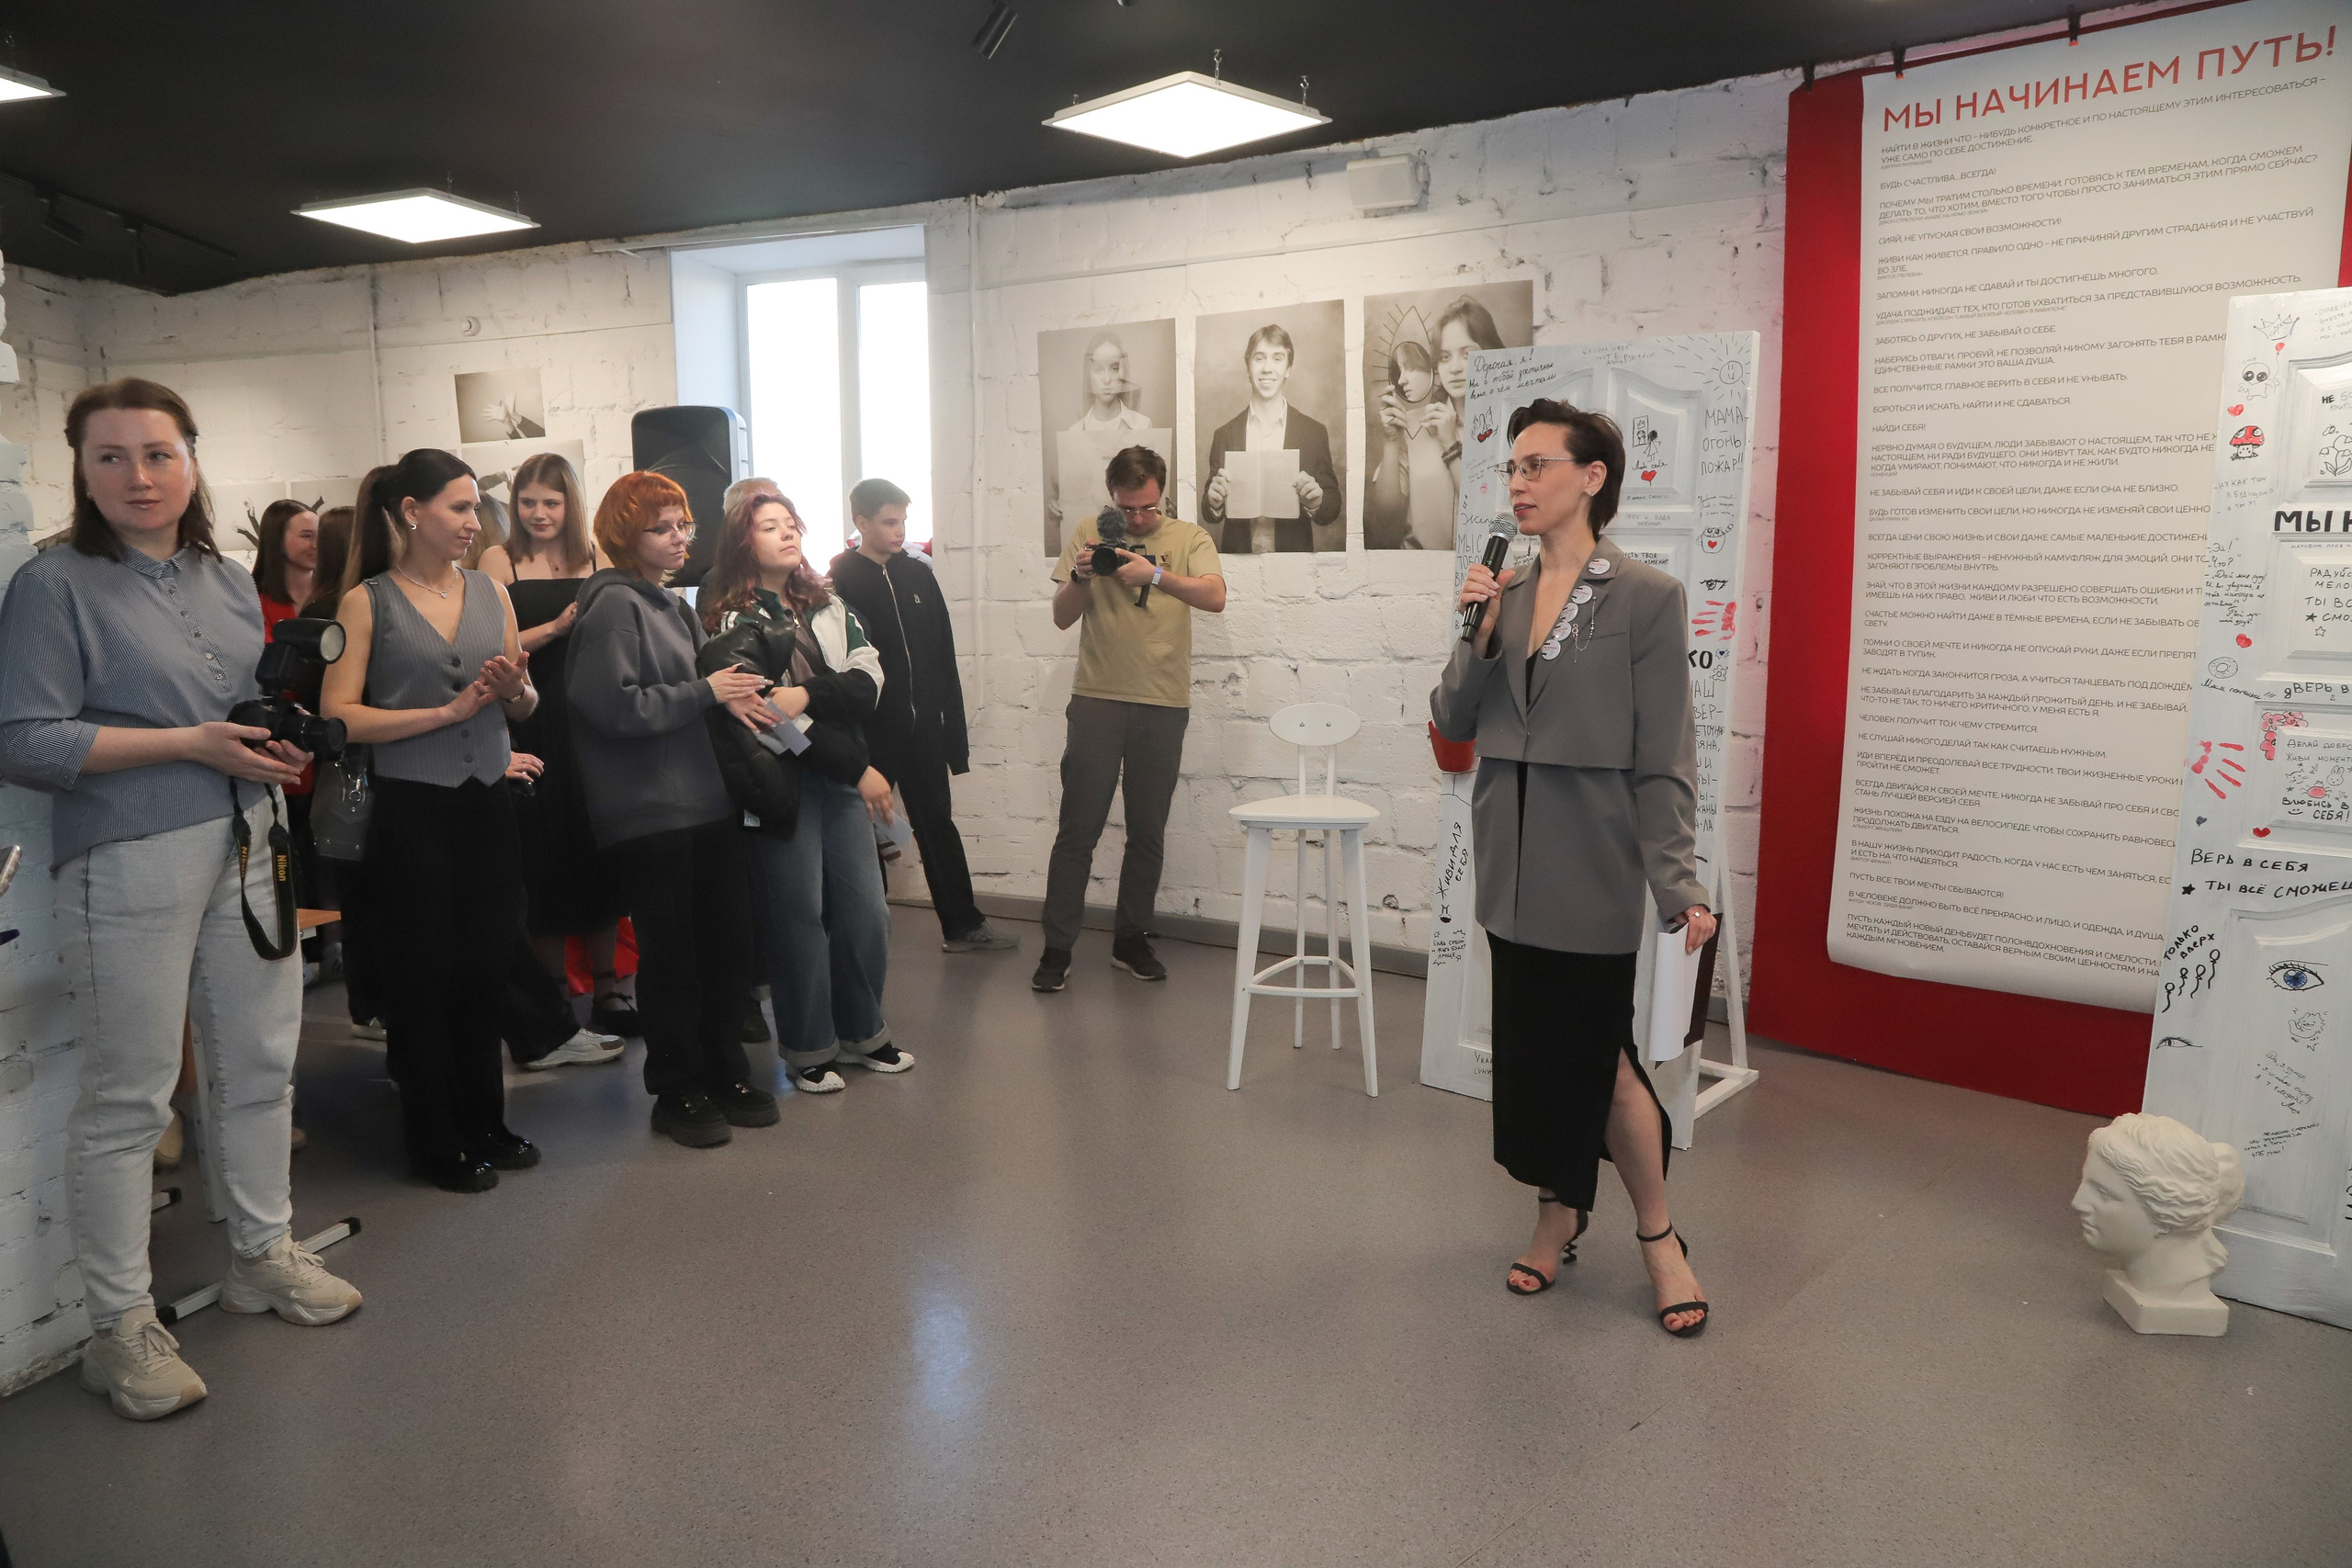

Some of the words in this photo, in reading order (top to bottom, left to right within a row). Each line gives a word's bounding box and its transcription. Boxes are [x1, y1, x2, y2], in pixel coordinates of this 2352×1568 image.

[1883, 97, 1941, 132] МЫ
[1955, 55, 2179, 121] НАЧИНАЕМ
[2197, 25, 2335, 80] ПУТЬ!
[2018, 116, 2081, 133] КОНКРЕТНОЕ
[2215, 76, 2318, 102] ИНТЕРЕСОВАТЬСЯ
[1902, 151, 1928, 161] САМО
[1880, 180, 1903, 190] БУДЬ
[1971, 185, 2014, 198] СТОЛЬКО
[2064, 173, 2115, 186] ГОТОВЯСЬ
[2122, 172, 2191, 189] ЗАНИМАТЬСЯ
[1917, 229, 1958, 241] УПУСКАЯ
[2065, 230, 2120, 245] ПРИЧИНЯЙ
[2165, 219, 2228, 234] СТРАДАНИЯ
[1921, 286, 1963, 296] НИКОГДА
[2039, 272, 2107, 287] ДОСТИГНЕШЬ
[2031, 294, 2092, 307] УХВАТИТЬСЯ
[2107, 283, 2213, 300] ПРЕДСТАВИВШУЮСЯ
[1874, 334, 1917, 345] ЗАБОТЯСЬ
[1977, 325, 2022, 338] ЗАБЫВАЙ
[1873, 354, 1918, 365] НАБЕРИСЬ
[2010, 343, 2062, 355] ПОЗВОЛЯЙ
[1873, 363, 1942, 375] ЕДИНСТВЕННЫЕ
[1493, 369, 1514, 383] тобой
[1944, 380, 1985, 389] ГЛАВНОЕ
[2322, 394, 2335, 404] НЕ
[1872, 403, 1917, 413] БОРОТЬСЯ
[1704, 406, 1743, 429] МАМА
[1871, 423, 1900, 433] НАЙДИ
[1702, 434, 1741, 452] ОГОНЬ
[2024, 437, 2077, 447] ЗАБЫВАЮТ
[2151, 444, 2199, 454] НИКОГДА
[2018, 459, 2063, 468] НИКОГДА
[2232, 478, 2247, 487] КАК
[1881, 486, 1921, 496] ЗАБЫВАЙ
[1918, 507, 1966, 515] ИЗМЕНИТЬ
[2037, 506, 2081, 515] НИКОГДА
[2274, 511, 2334, 532] МЫ
[2086, 533, 2146, 541] МАЛЕНЬКИЕ
[1867, 552, 1921, 560] КОРРЕКТНЫЕ
[1922, 552, 1981, 560] ВЫРАЖЕНИЯ
[1866, 561, 1910, 570] ЗАГОНЯЮТ
[1910, 562, 1962, 570] ПРОБЛЕМЫ
[2020, 583, 2078, 592] РАЗРЕШЕНО
[2079, 584, 2139, 594] СОВЕРШАТЬ
[1865, 591, 1901, 599] ИМЕЕШЬ
[2224, 592, 2255, 602] никогда
[2305, 596, 2326, 606] ТЫ
[1864, 609, 1899, 618] СЧАСТЬЕ
[2132, 617, 2185, 626] ЗАБЫВАТЬ
[1862, 648, 1898, 657] ЗАВОДЯТ
[1970, 642, 2013, 652] НИКОГДА
[1931, 670, 1989, 681] ЗАКОНЧИТСЯ
[2072, 677, 2126, 688] ТАНЦЕВАТЬ
[1860, 694, 1888, 704] ЧТО-ТО
[1911, 688, 1974, 699] БЛАГОДАРИТЬ
[2030, 694, 2086, 705] ПРОЖИТЫЙ
[1859, 713, 1895, 723] ЧЕЛОВЕК
[2009, 743, 2060, 754] СЧИТАЕШЬ
[1856, 760, 1889, 770] ПРОЙТИ
[1916, 755, 1981, 768] ПРЕОДОЛЕВАЙ
[2082, 769, 2144, 783] ЖИЗНЕННЫЕ
[1884, 782, 1929, 792] ДВИГАЙСЯ
[1917, 794, 1957, 805] ВЕРСИЕЙ
[2312, 809, 2350, 822] СЕБЯ!
[1852, 815, 1911, 829] ПРОДОЛЖАТЬ
[2065, 828, 2120, 841] СОХРАНИТЬ
[1858, 849, 1878, 858] ЕСТЬ
[1915, 846, 1961, 859] ПРИХОДИТ
[277, 854, 287, 882] Nikon
[1455, 848, 1468, 882] СЕБЯ
[2243, 858, 2253, 867] В
[2260, 860, 2309, 873] СЕБЯ
[2204, 880, 2231, 891] ТЫ
[2239, 884, 2267, 895] ВСЁ
[1855, 890, 1898, 903] ЧЕЛОВЕКЕ
[1872, 917, 1912, 929] КАЖДЫЙ
[1846, 931, 1885, 942] КАЖДЫМ
[2164, 925, 2199, 960] ТОЛЬКО
[1951, 938, 2001, 953] ОСТАВАЙСЯ
[2076, 957, 2136, 973] ЦЕННОСТЯМ
